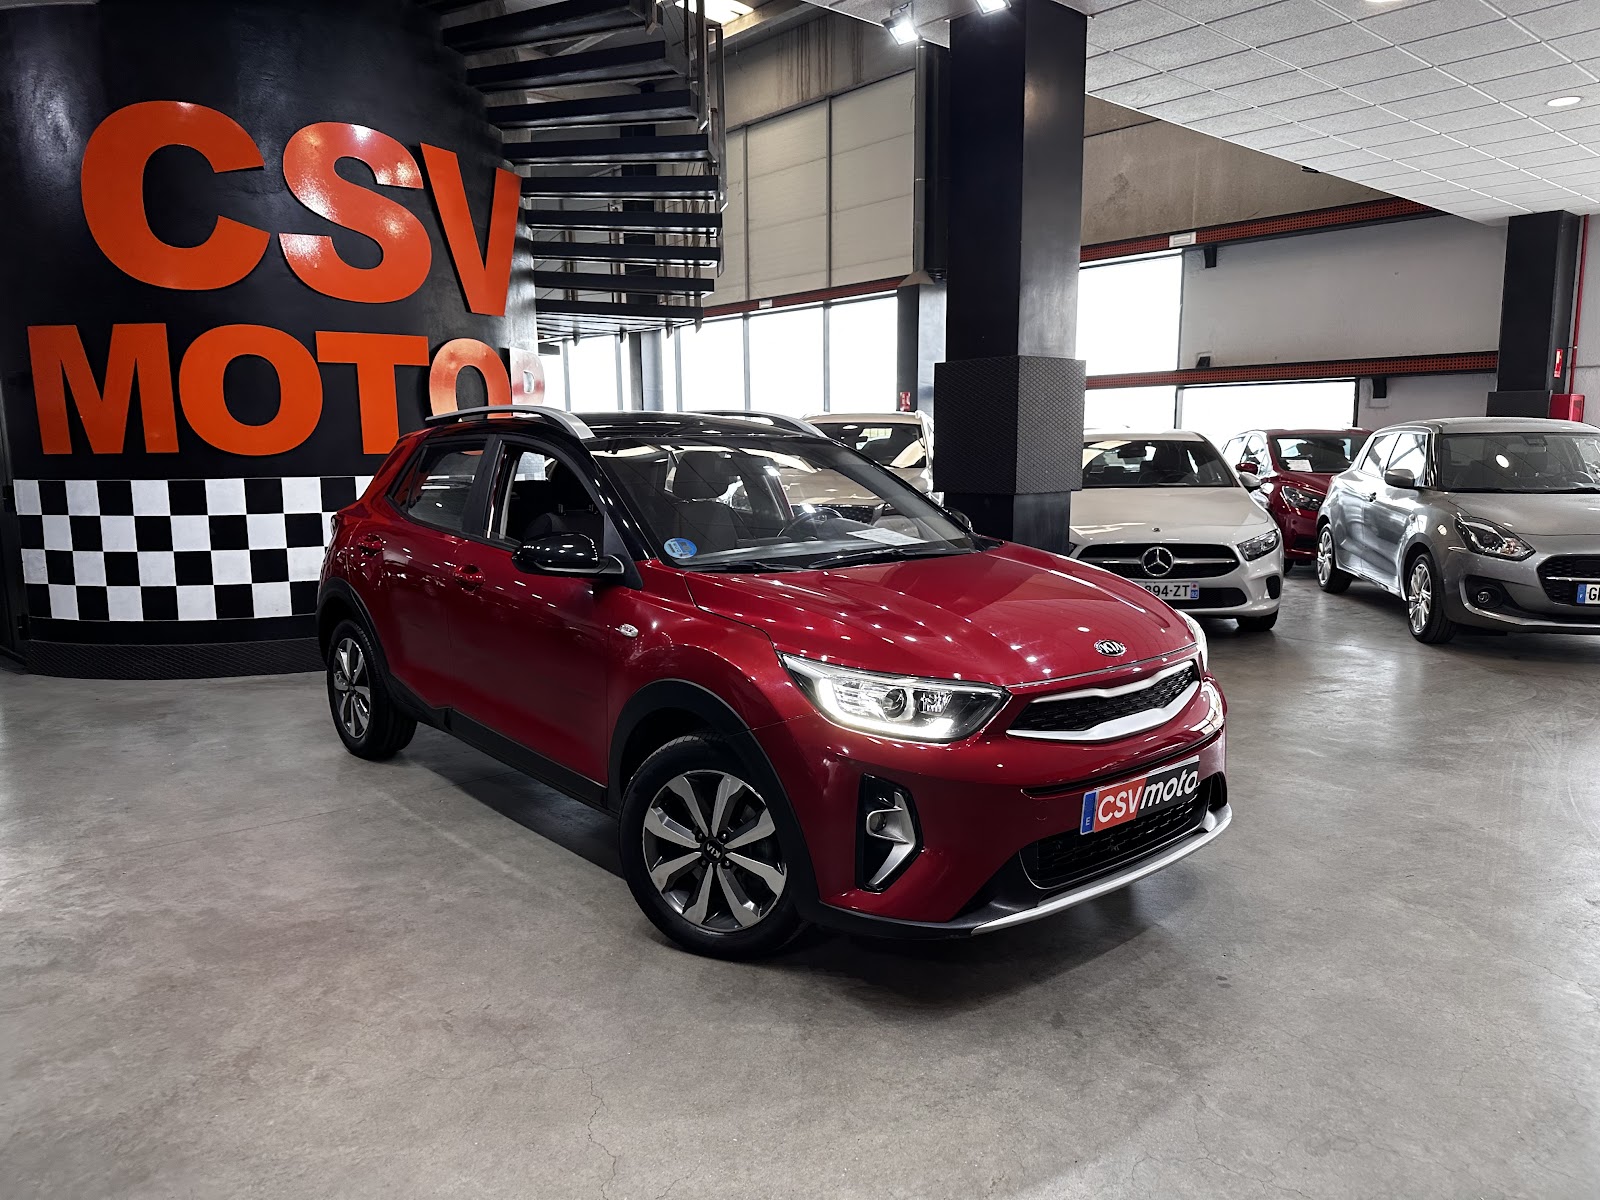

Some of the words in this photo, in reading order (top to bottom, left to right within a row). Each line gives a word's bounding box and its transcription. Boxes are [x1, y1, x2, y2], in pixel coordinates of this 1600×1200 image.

[81, 100, 521, 317] CSV
[1098, 640, 1124, 654] KIA
[1085, 816, 1091, 826] E
[706, 843, 721, 859] KIA
